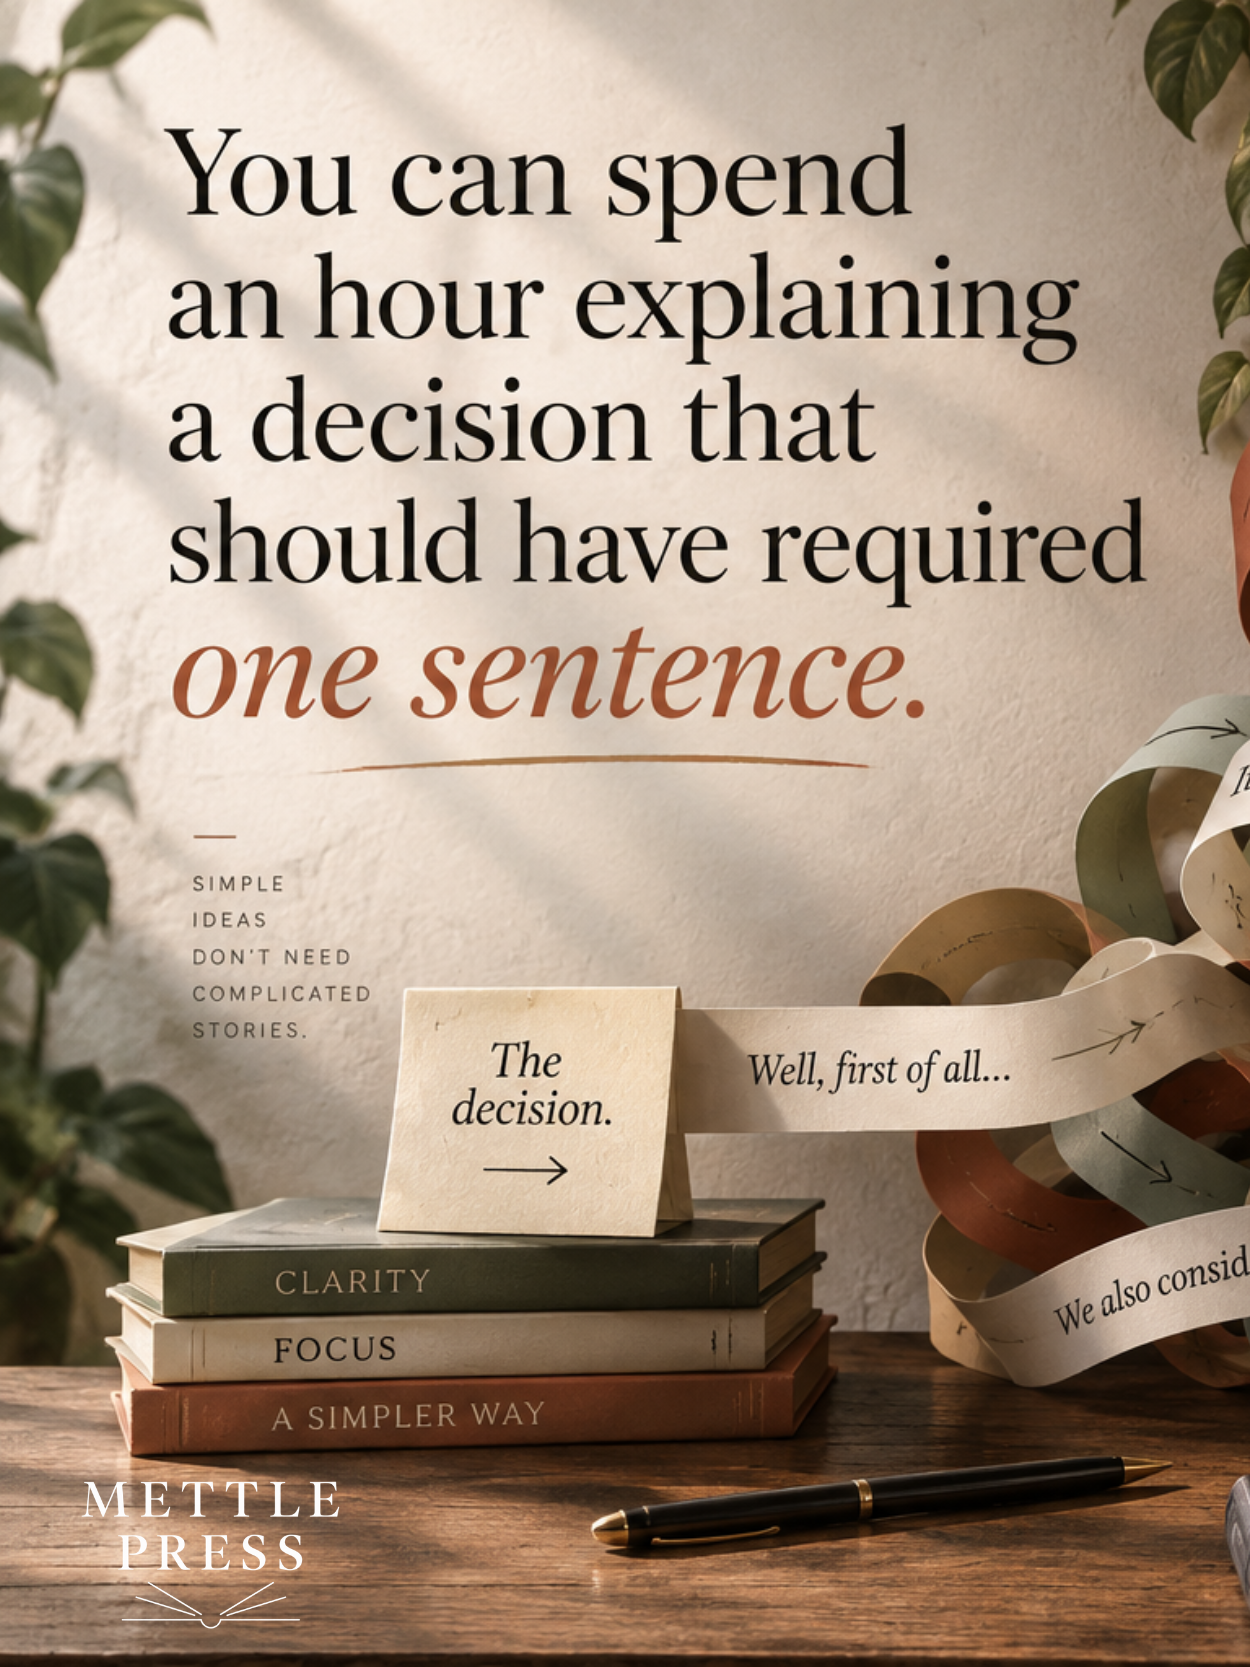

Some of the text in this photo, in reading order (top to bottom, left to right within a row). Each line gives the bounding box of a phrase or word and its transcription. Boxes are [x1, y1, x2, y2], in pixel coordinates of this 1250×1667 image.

[491, 1040, 562, 1079] The
[747, 1049, 1012, 1095] Well, first of all...
[451, 1088, 614, 1126] decision.
[274, 1268, 432, 1296] CLARITY
[1053, 1298, 1096, 1335] We
[1101, 1279, 1151, 1317] also
[273, 1335, 397, 1365] FOCUS
[271, 1401, 545, 1433] A SIMPLER WAY
